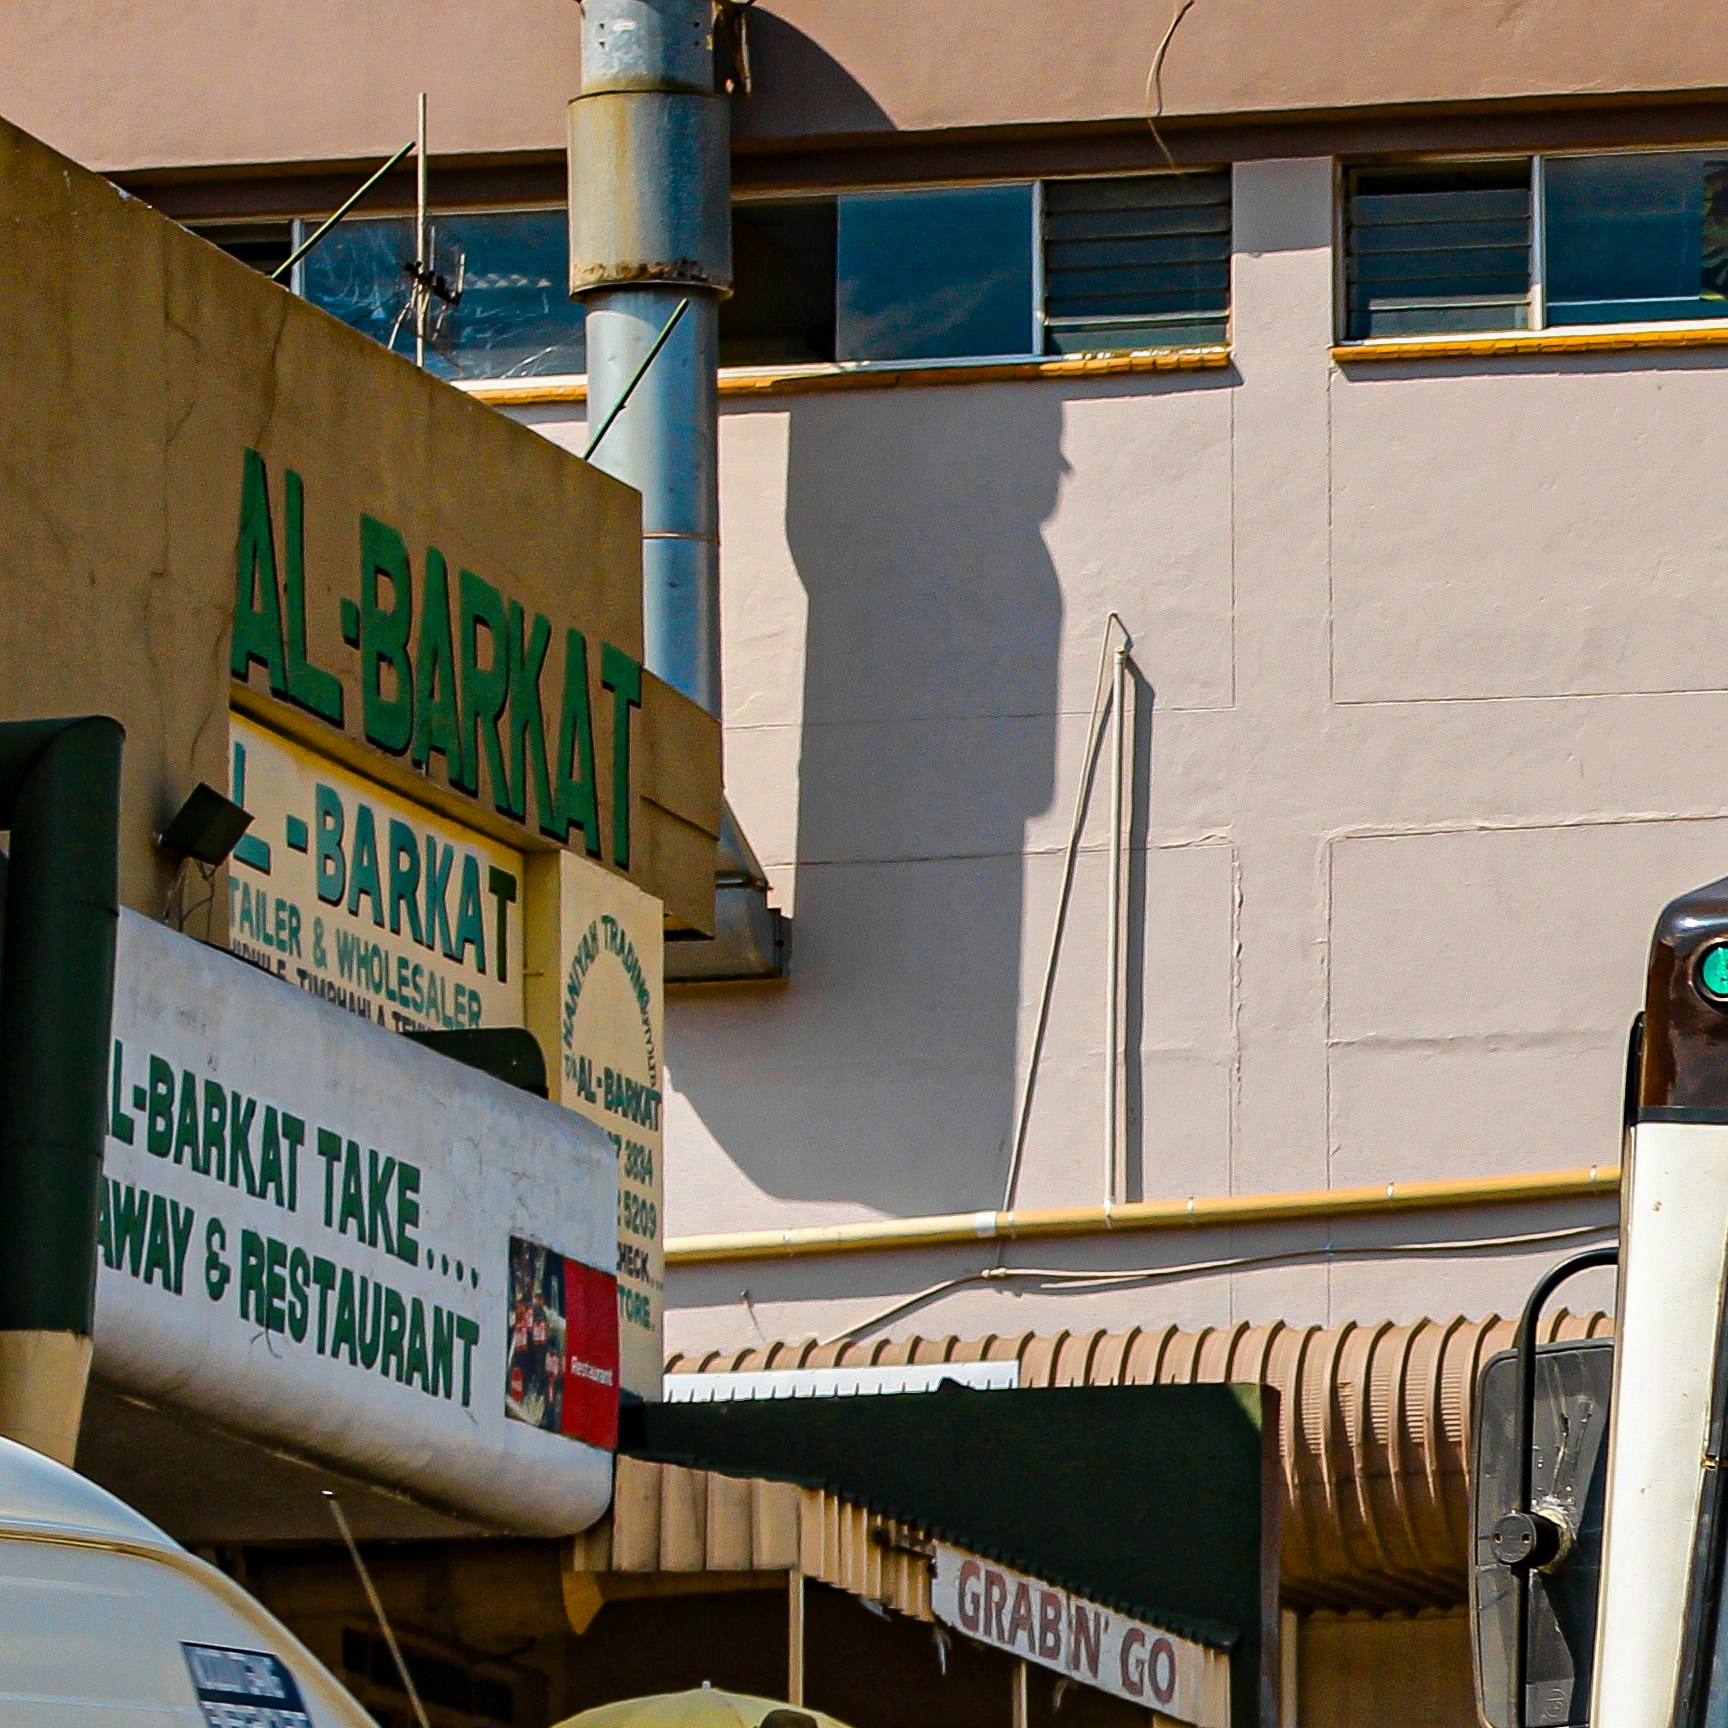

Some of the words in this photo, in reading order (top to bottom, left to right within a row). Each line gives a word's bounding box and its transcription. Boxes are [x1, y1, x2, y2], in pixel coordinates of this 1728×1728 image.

[230, 446, 643, 871] AL-BARKAT
[312, 916, 328, 970] &
[336, 928, 482, 1029] WHOLESALER
[600, 914, 651, 1016] TRADING
[577, 1054, 664, 1131] AL-BARKAT
[205, 1217, 231, 1302] &
[239, 1228, 480, 1408] RESTAURANT
[1120, 1627, 1177, 1704] GO
